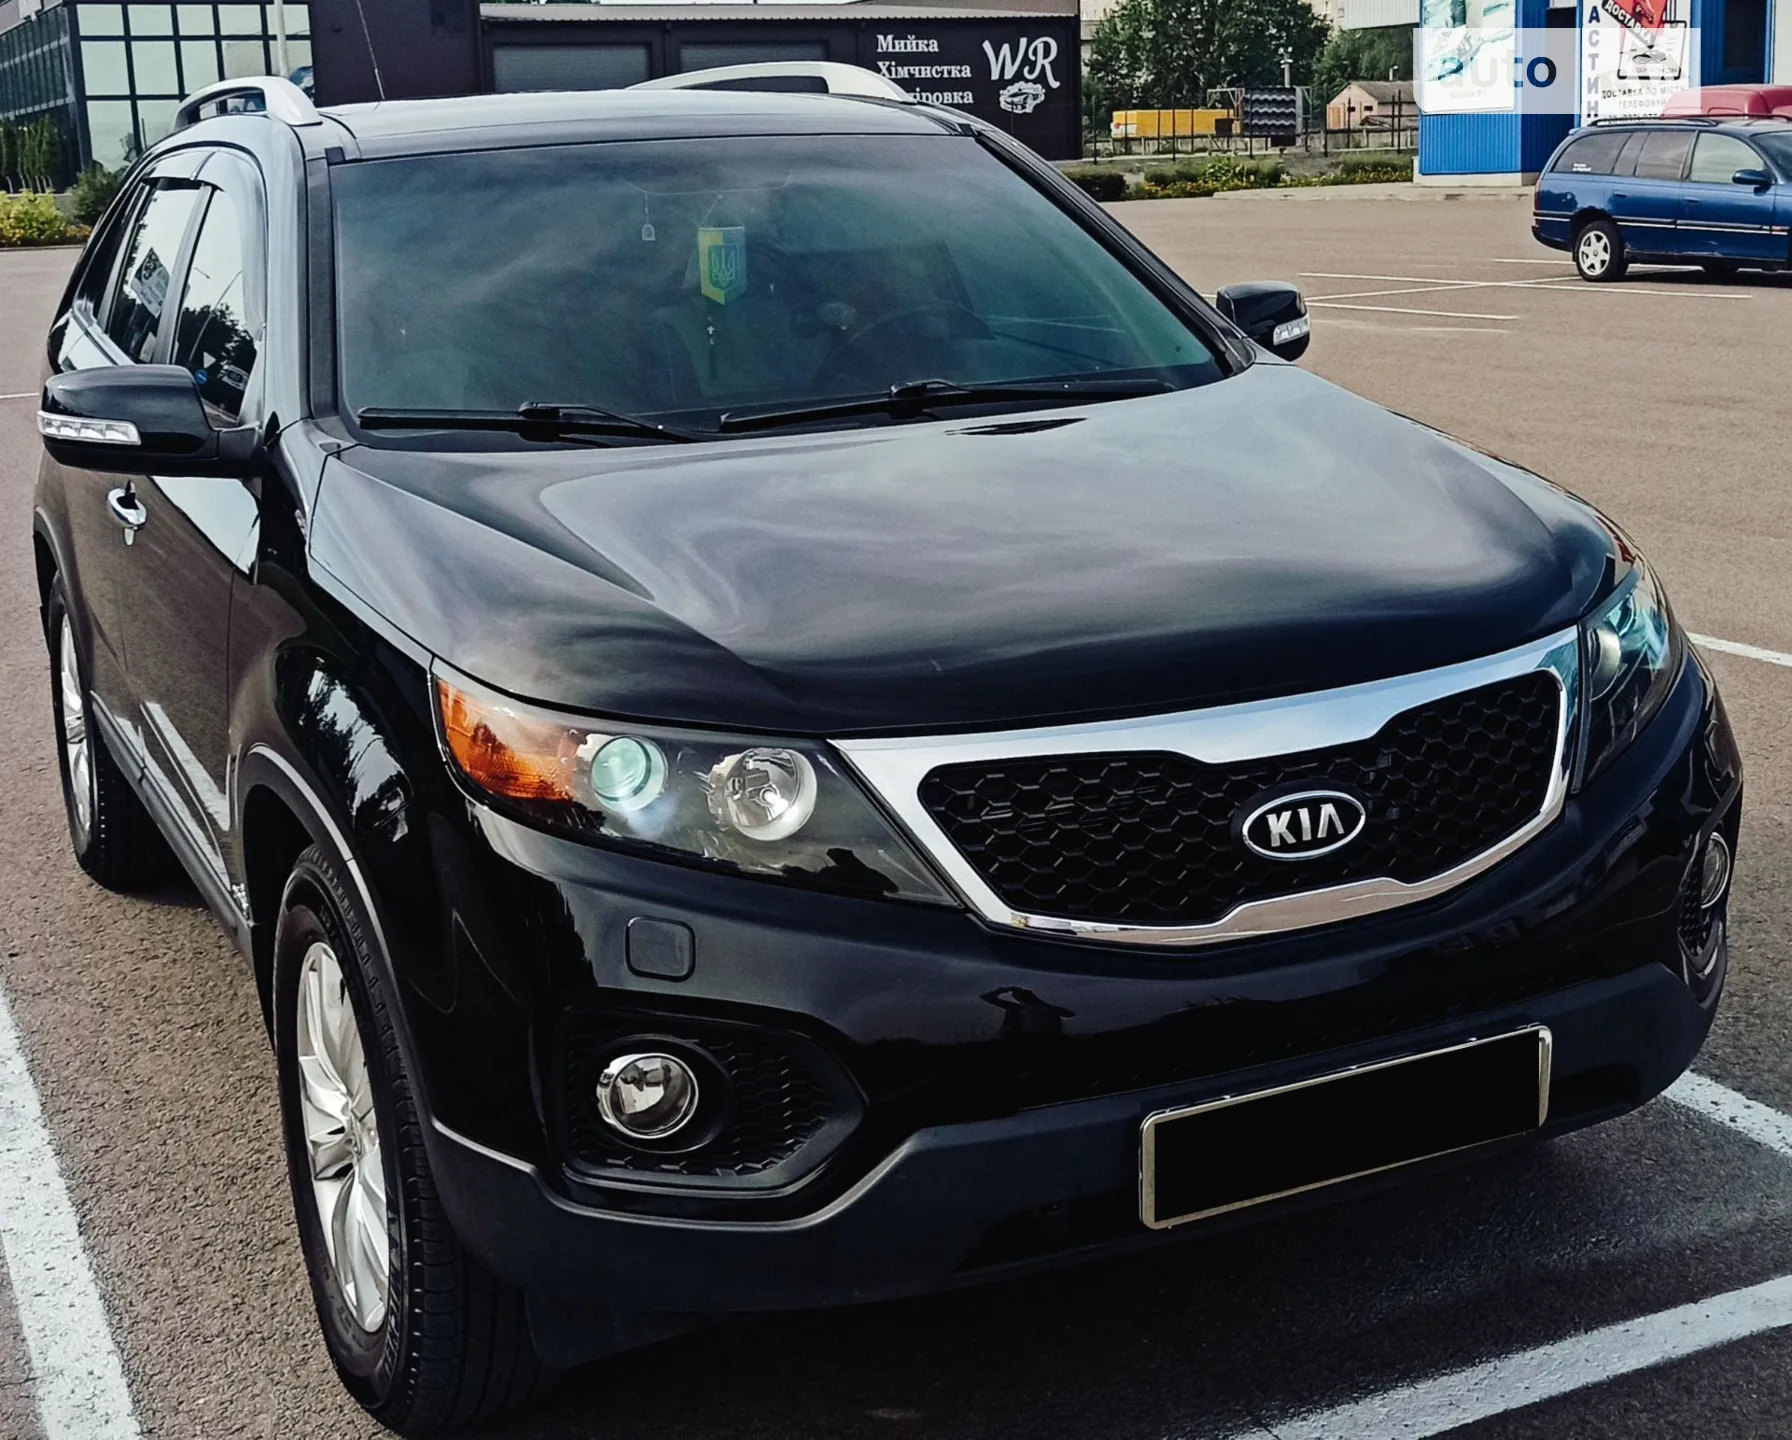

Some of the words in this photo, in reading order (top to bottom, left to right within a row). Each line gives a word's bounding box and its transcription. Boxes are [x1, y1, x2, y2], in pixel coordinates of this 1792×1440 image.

[876, 34, 939, 53] Мийка
[877, 61, 972, 79] Хімчистка
[982, 36, 1061, 89] WR
[1266, 803, 1345, 847] KIA
